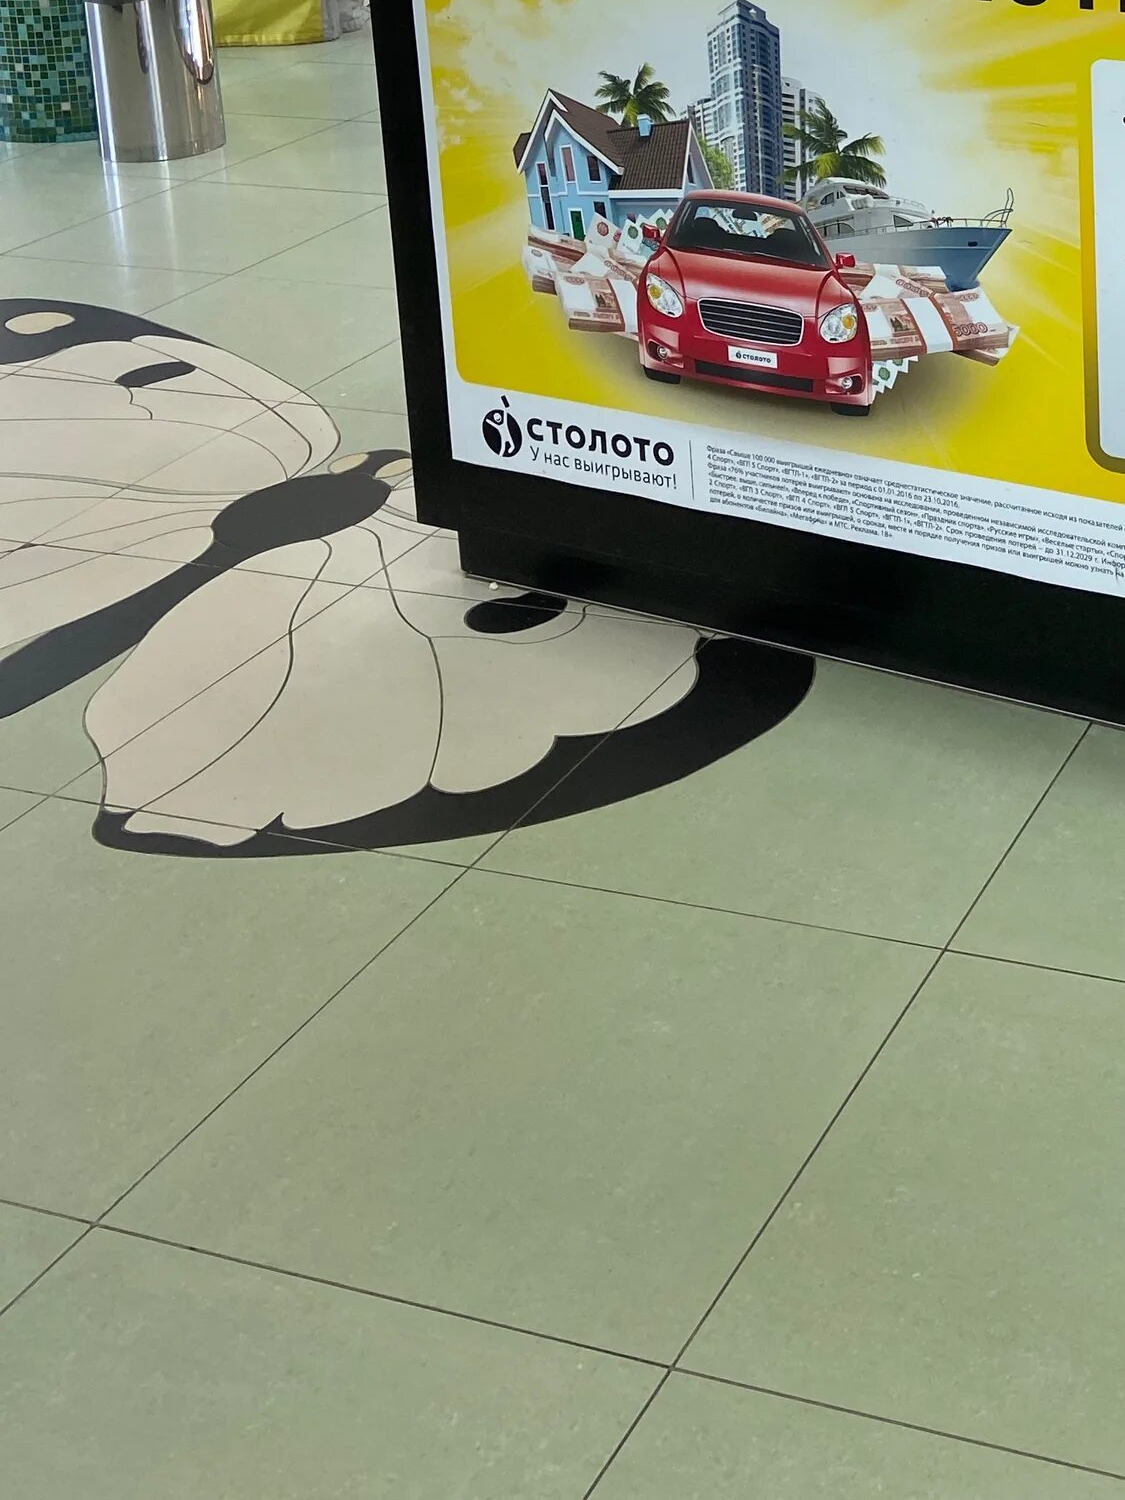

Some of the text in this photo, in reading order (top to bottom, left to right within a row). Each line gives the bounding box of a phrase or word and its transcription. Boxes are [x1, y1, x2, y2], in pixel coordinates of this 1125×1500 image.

[742, 353, 771, 363] СТОЛОТО
[527, 418, 674, 466] СТОЛОТО
[529, 446, 677, 490] У нас выигрывают!
